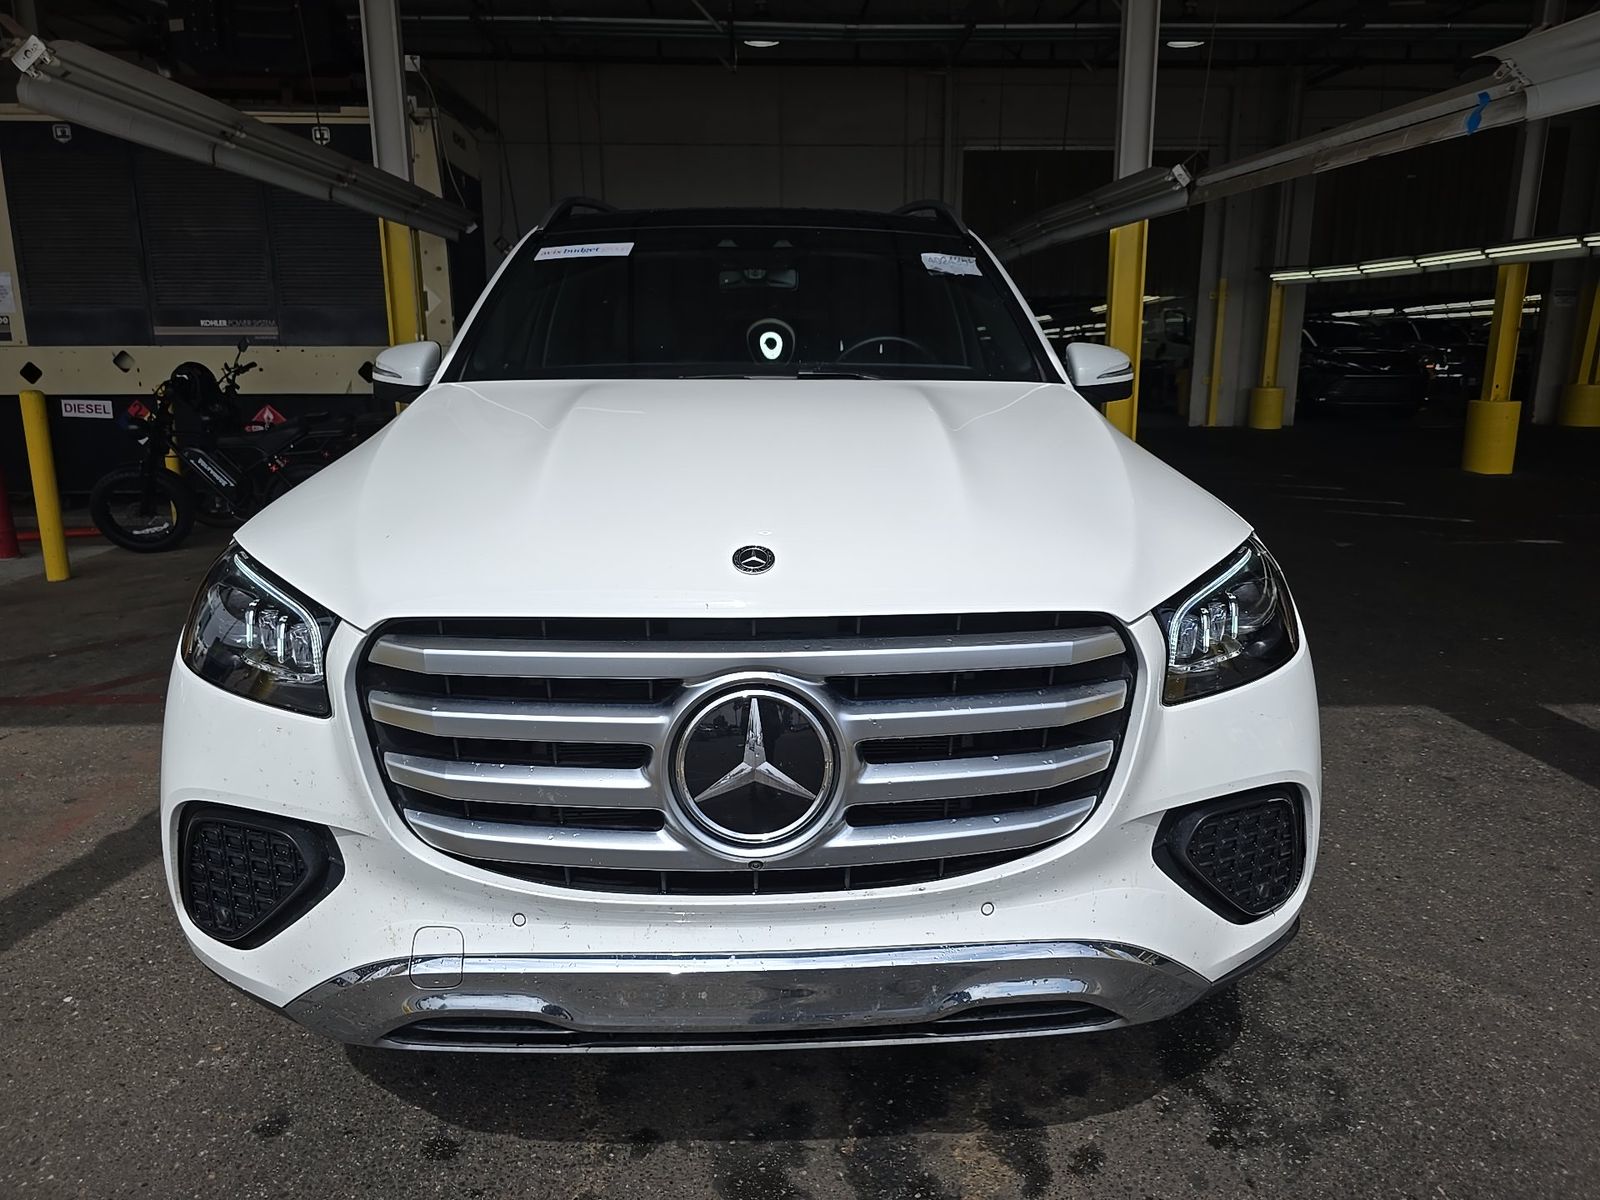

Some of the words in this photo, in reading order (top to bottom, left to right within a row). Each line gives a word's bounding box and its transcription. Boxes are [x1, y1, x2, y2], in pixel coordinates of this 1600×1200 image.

[564, 246, 600, 255] budget
[200, 319, 227, 327] KOHLER
[64, 403, 111, 415] DIESEL
